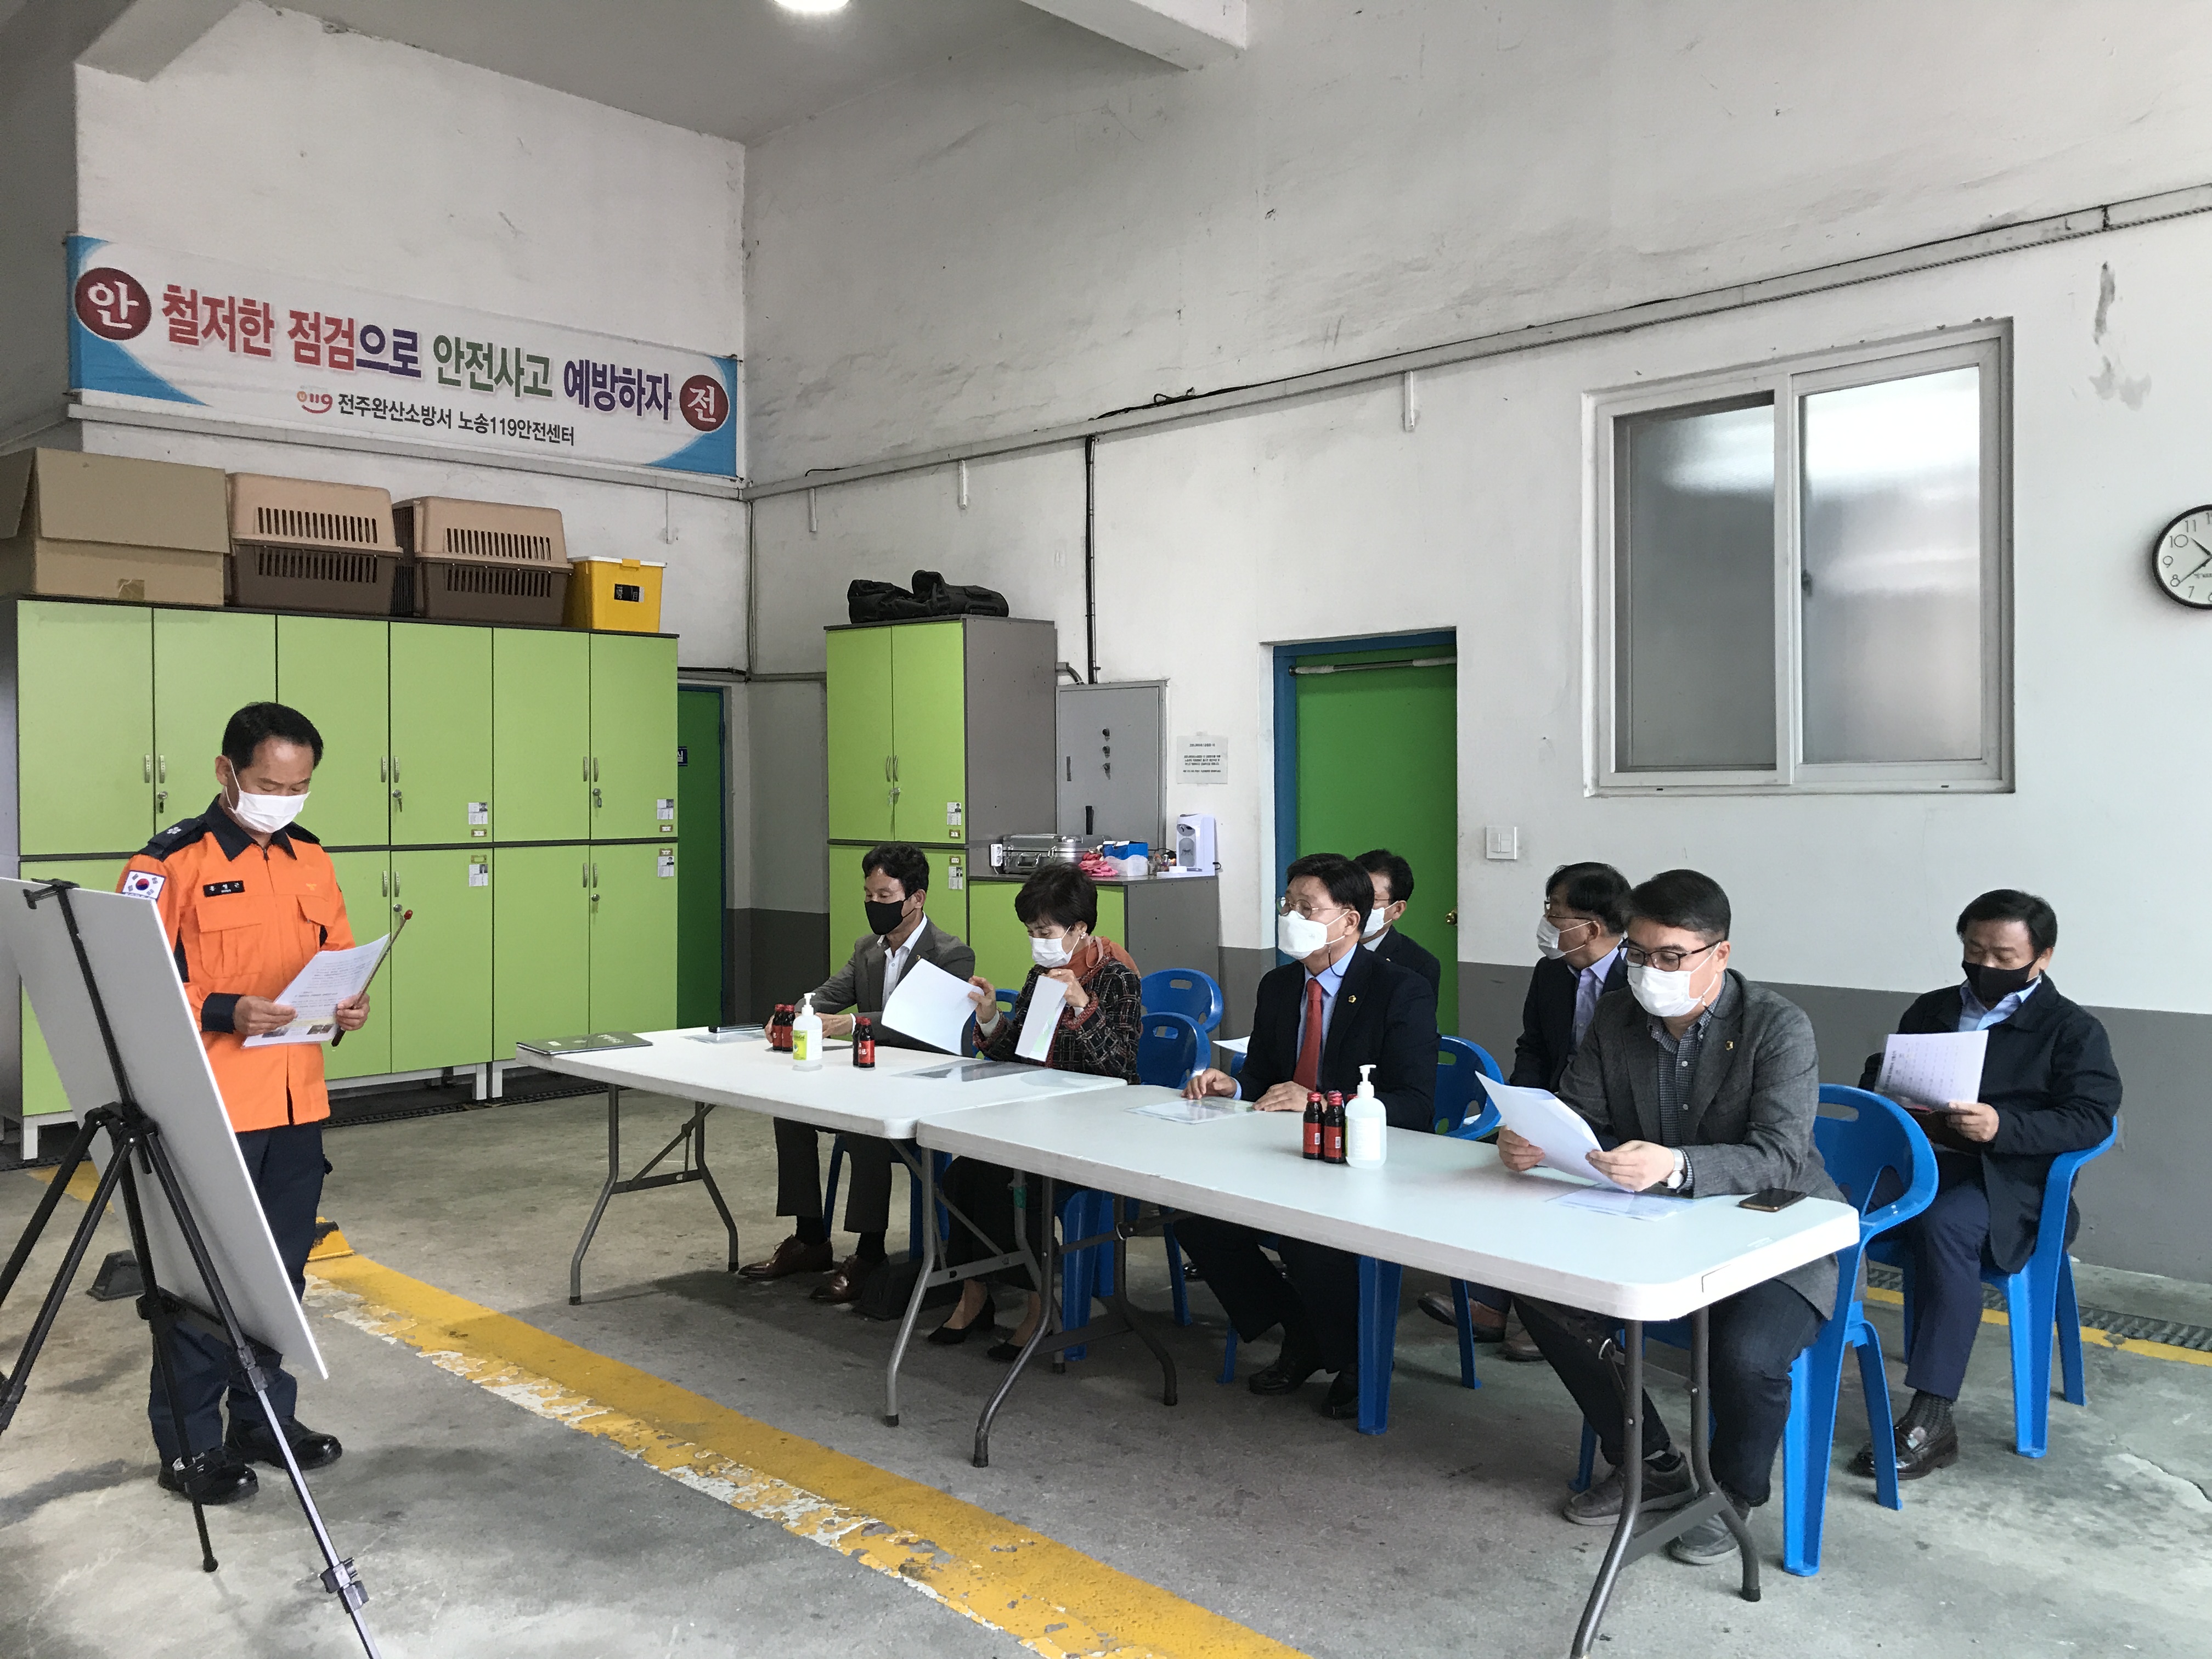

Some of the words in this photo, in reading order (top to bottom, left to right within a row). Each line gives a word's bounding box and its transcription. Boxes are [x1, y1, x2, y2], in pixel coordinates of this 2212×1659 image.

[88, 281, 139, 330] 안
[162, 284, 275, 357] 철저한
[288, 309, 421, 378] 점검으로
[433, 334, 553, 398] 안전사고
[564, 359, 672, 420] 예방하자
[688, 385, 716, 424] 전
[338, 393, 452, 429] 전주완산소방서
[458, 413, 575, 446] 노송119안전센터
[2185, 520, 2197, 532] 11
[2170, 534, 2189, 548] 10
[2163, 556, 2174, 568] 9
[2170, 574, 2181, 587] 8
[2188, 586, 2194, 599] 7
